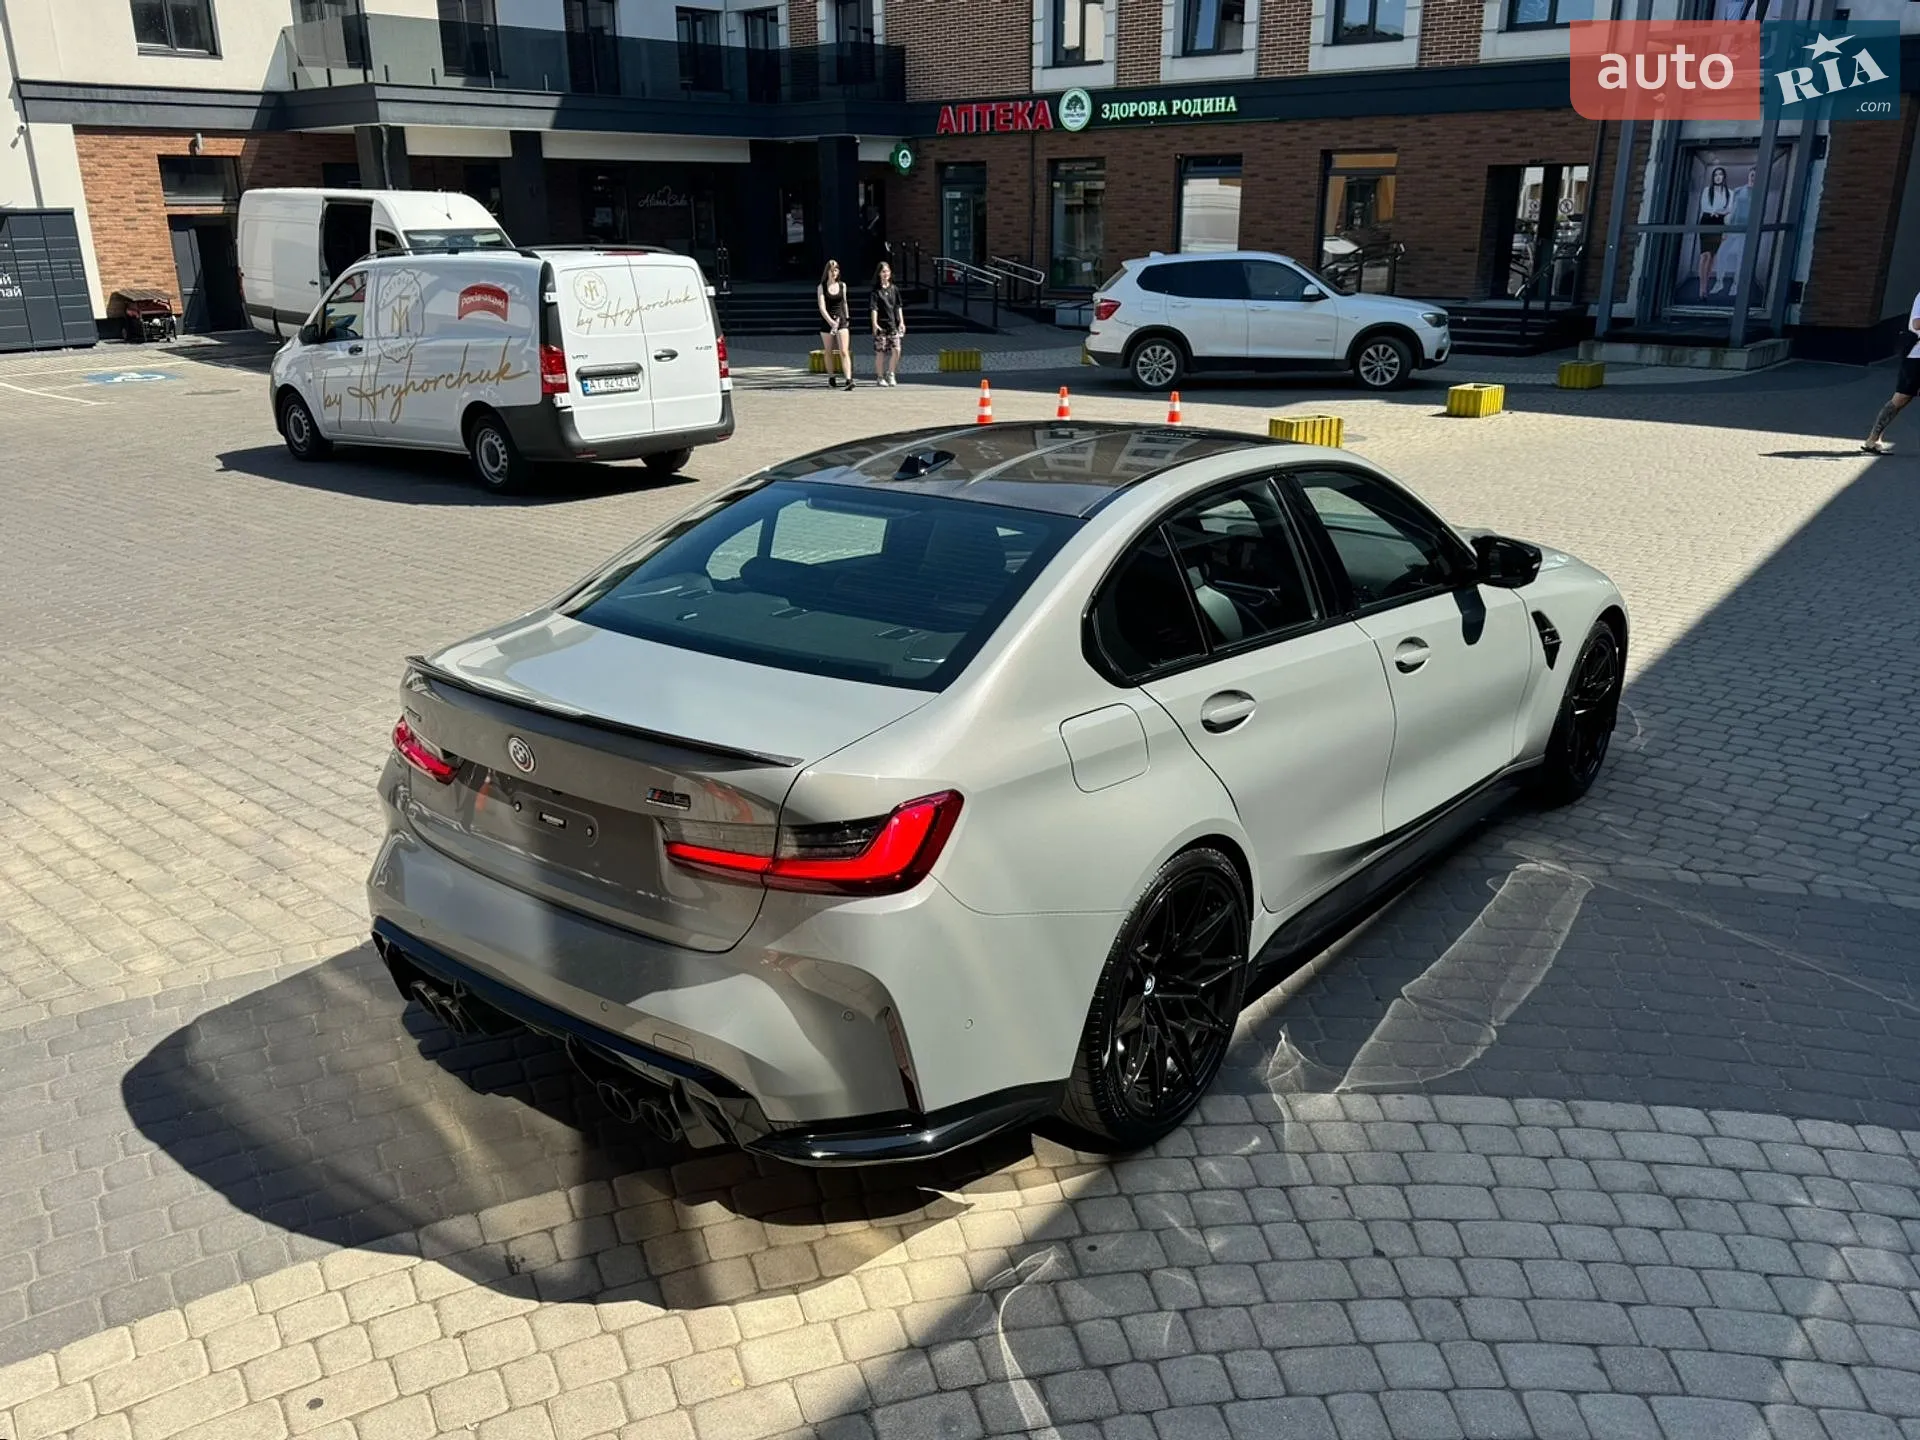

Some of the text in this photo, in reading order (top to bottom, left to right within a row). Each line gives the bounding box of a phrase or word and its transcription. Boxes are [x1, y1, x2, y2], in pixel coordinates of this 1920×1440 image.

[936, 96, 1237, 135] АПТЕКА ЗДОРОВА РОДИНА
[322, 336, 530, 430] by Hryhorchuk
